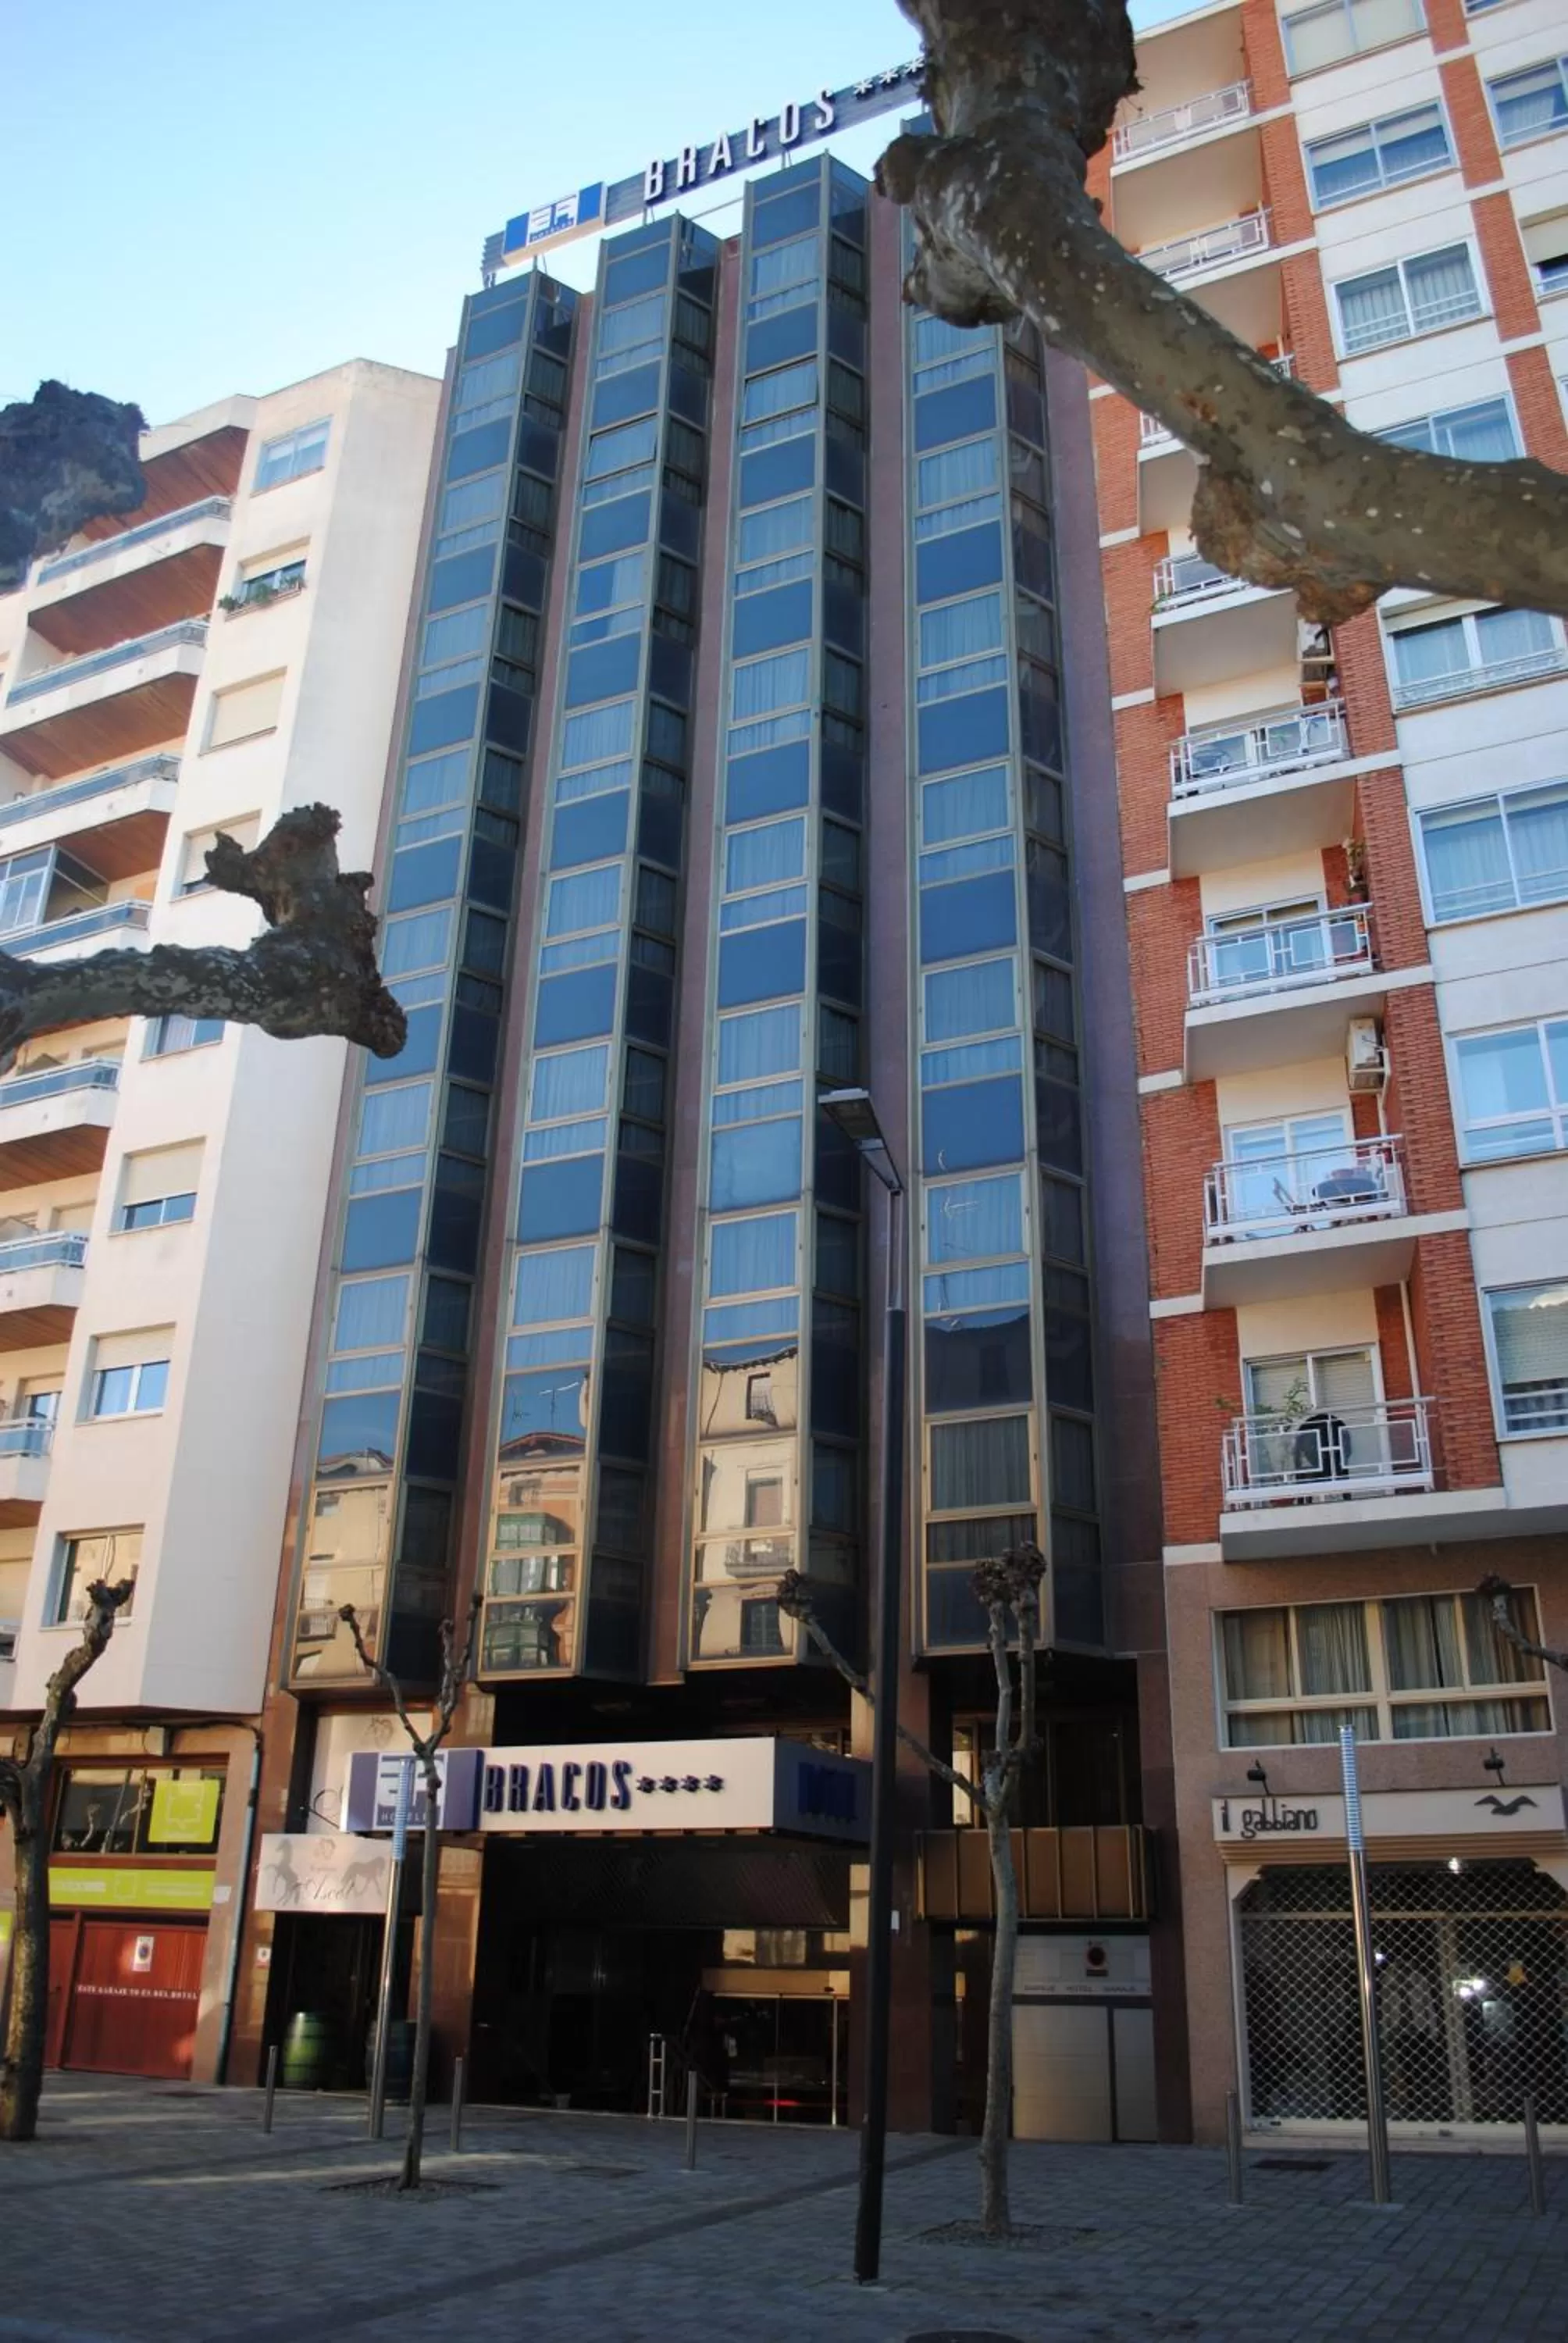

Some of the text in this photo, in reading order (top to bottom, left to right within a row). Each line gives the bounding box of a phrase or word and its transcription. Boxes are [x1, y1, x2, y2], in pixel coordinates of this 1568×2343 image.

[643, 87, 835, 202] BRACOS
[482, 1760, 632, 1813] BRACOS
[1240, 1798, 1318, 1838] gabbiano
